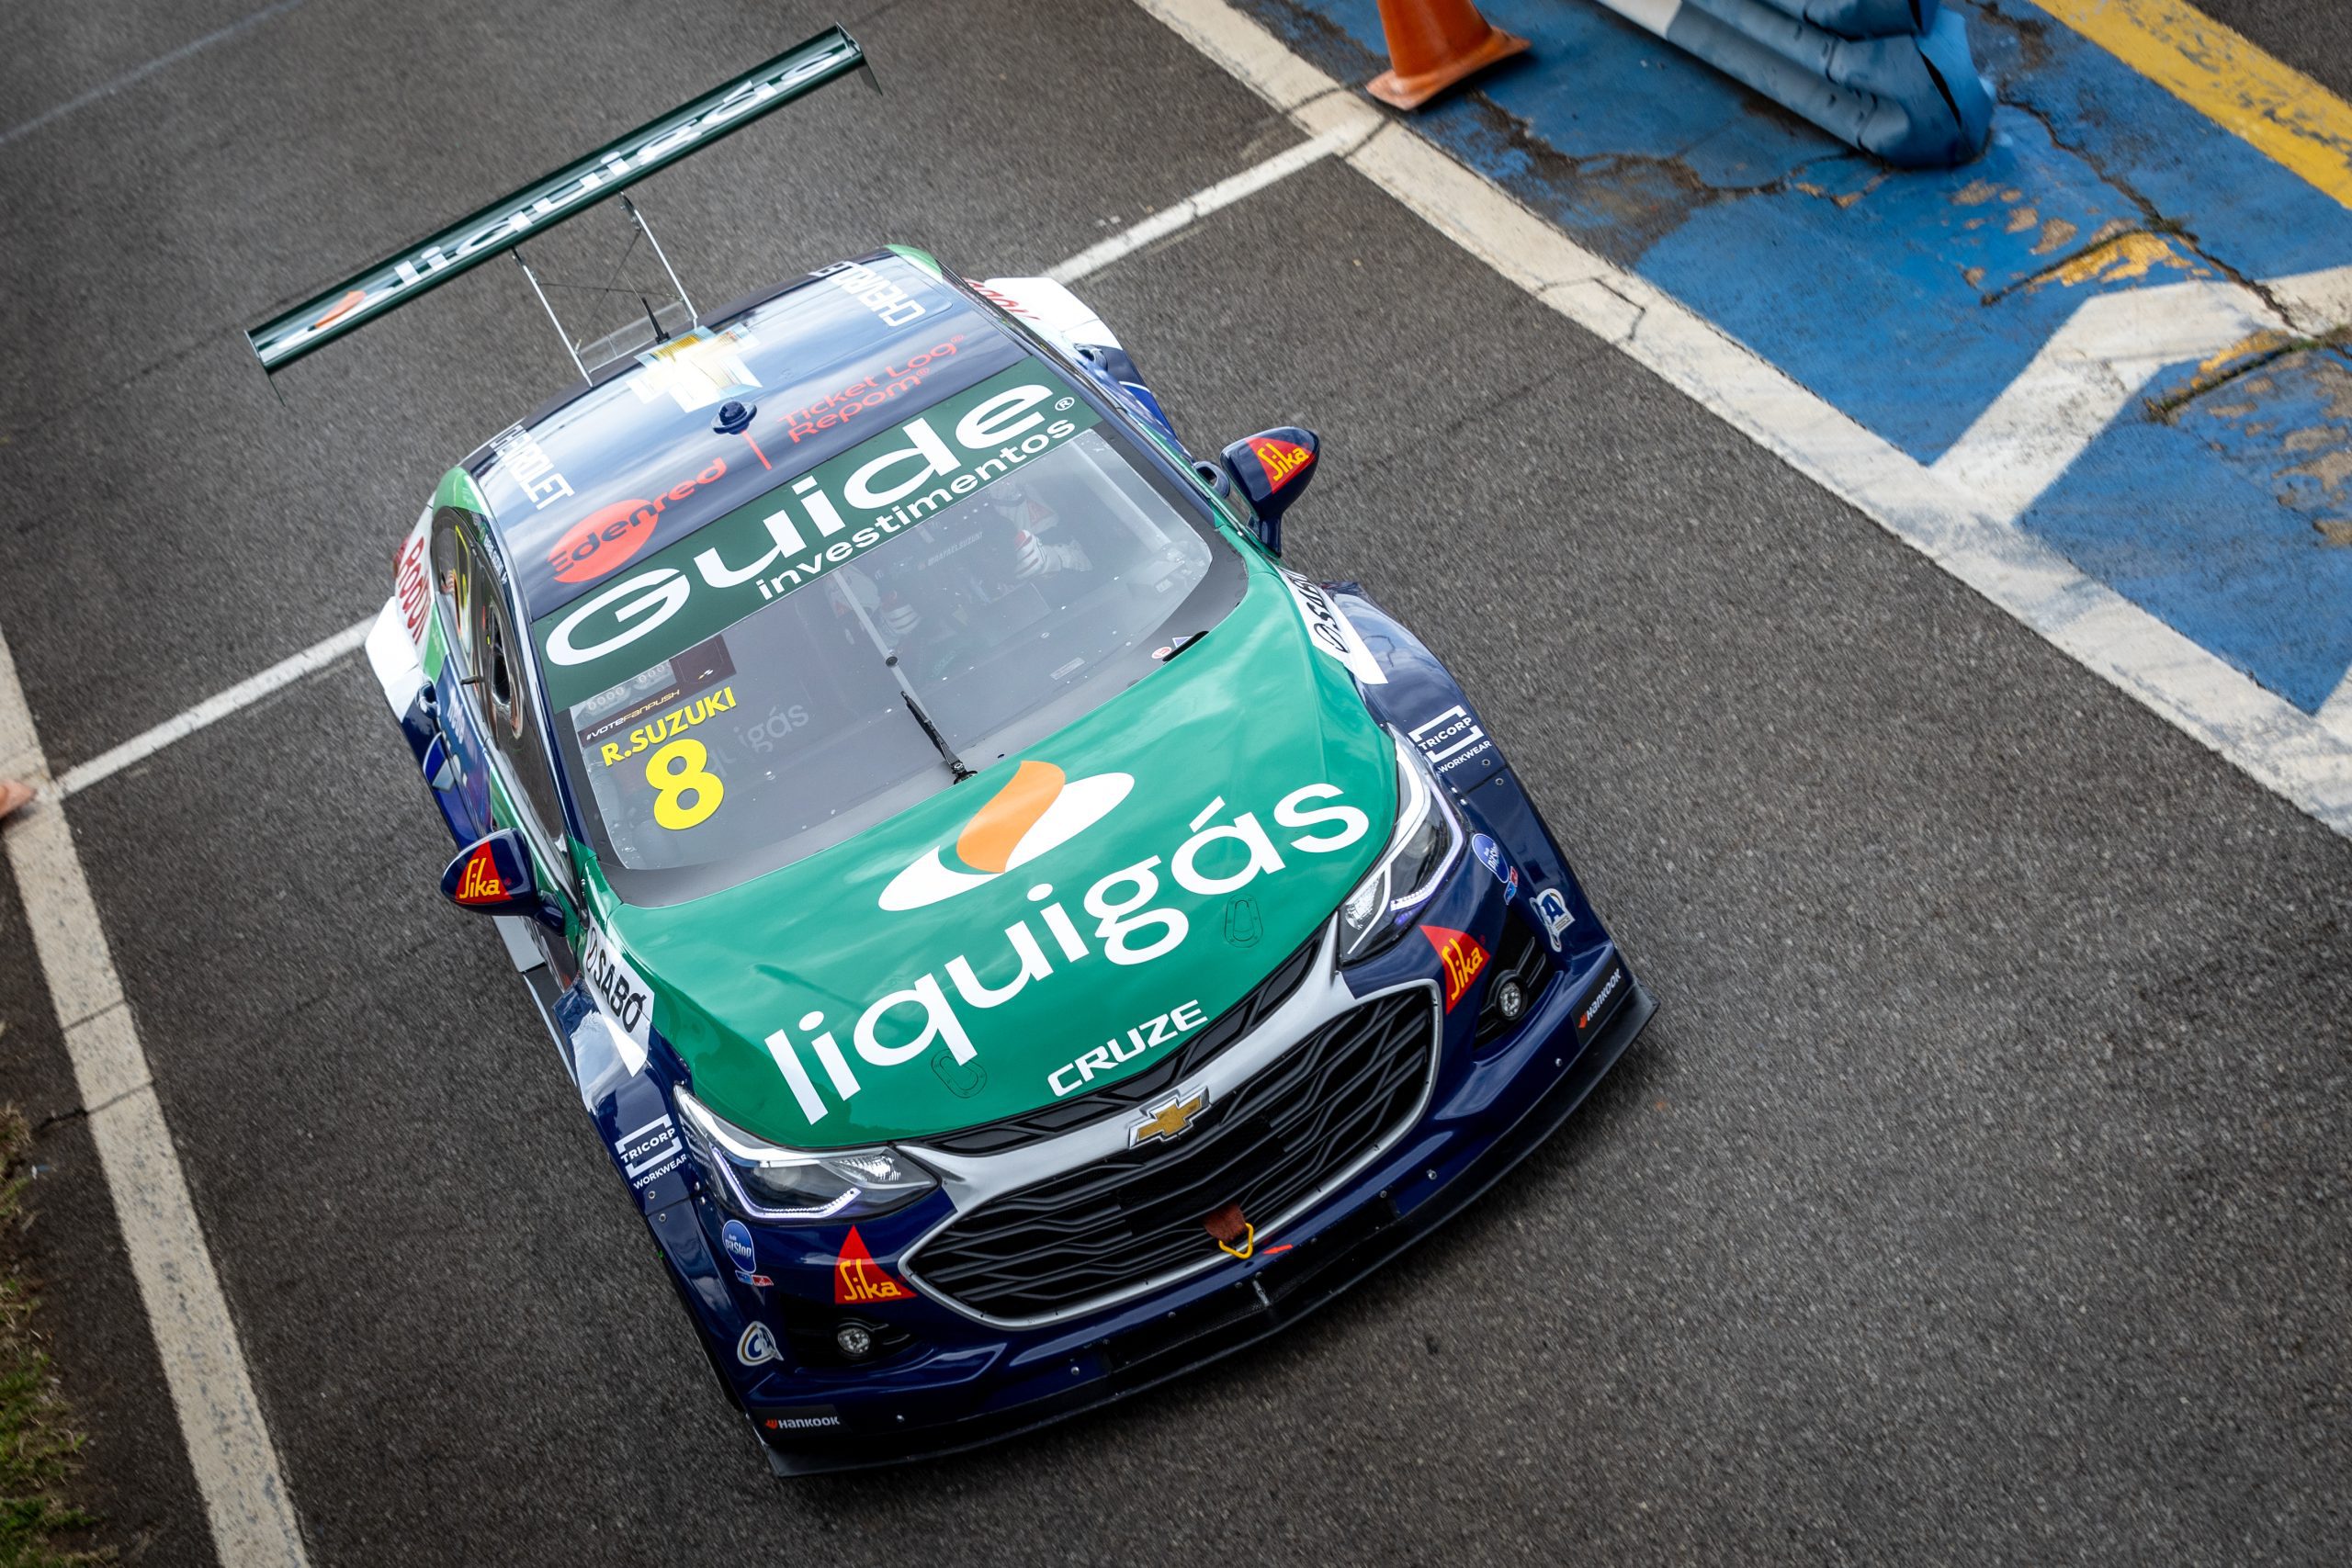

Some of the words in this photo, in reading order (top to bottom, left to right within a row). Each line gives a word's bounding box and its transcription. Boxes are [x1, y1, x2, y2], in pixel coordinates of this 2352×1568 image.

[777, 375, 878, 427] Ticket
[885, 342, 957, 378] Log
[787, 374, 922, 444] Repom
[1256, 442, 1309, 481] Sika
[546, 384, 1054, 666] Guide
[547, 457, 727, 579] Edenred
[756, 419, 1076, 600] investimentos
[601, 686, 737, 766] R.SUZUKI
[1419, 716, 1472, 750] TRICORP
[1438, 739, 1492, 773] WORKWEAR
[645, 739, 724, 829] 8
[458, 857, 501, 899] Sika
[764, 783, 1370, 1125] liquigás
[1441, 937, 1483, 1001] Sika
[1047, 998, 1208, 1098] CRUZE
[620, 1126, 676, 1165] TRICORP
[633, 1153, 688, 1191] WORKWEAR
[839, 1258, 901, 1302] Sika
